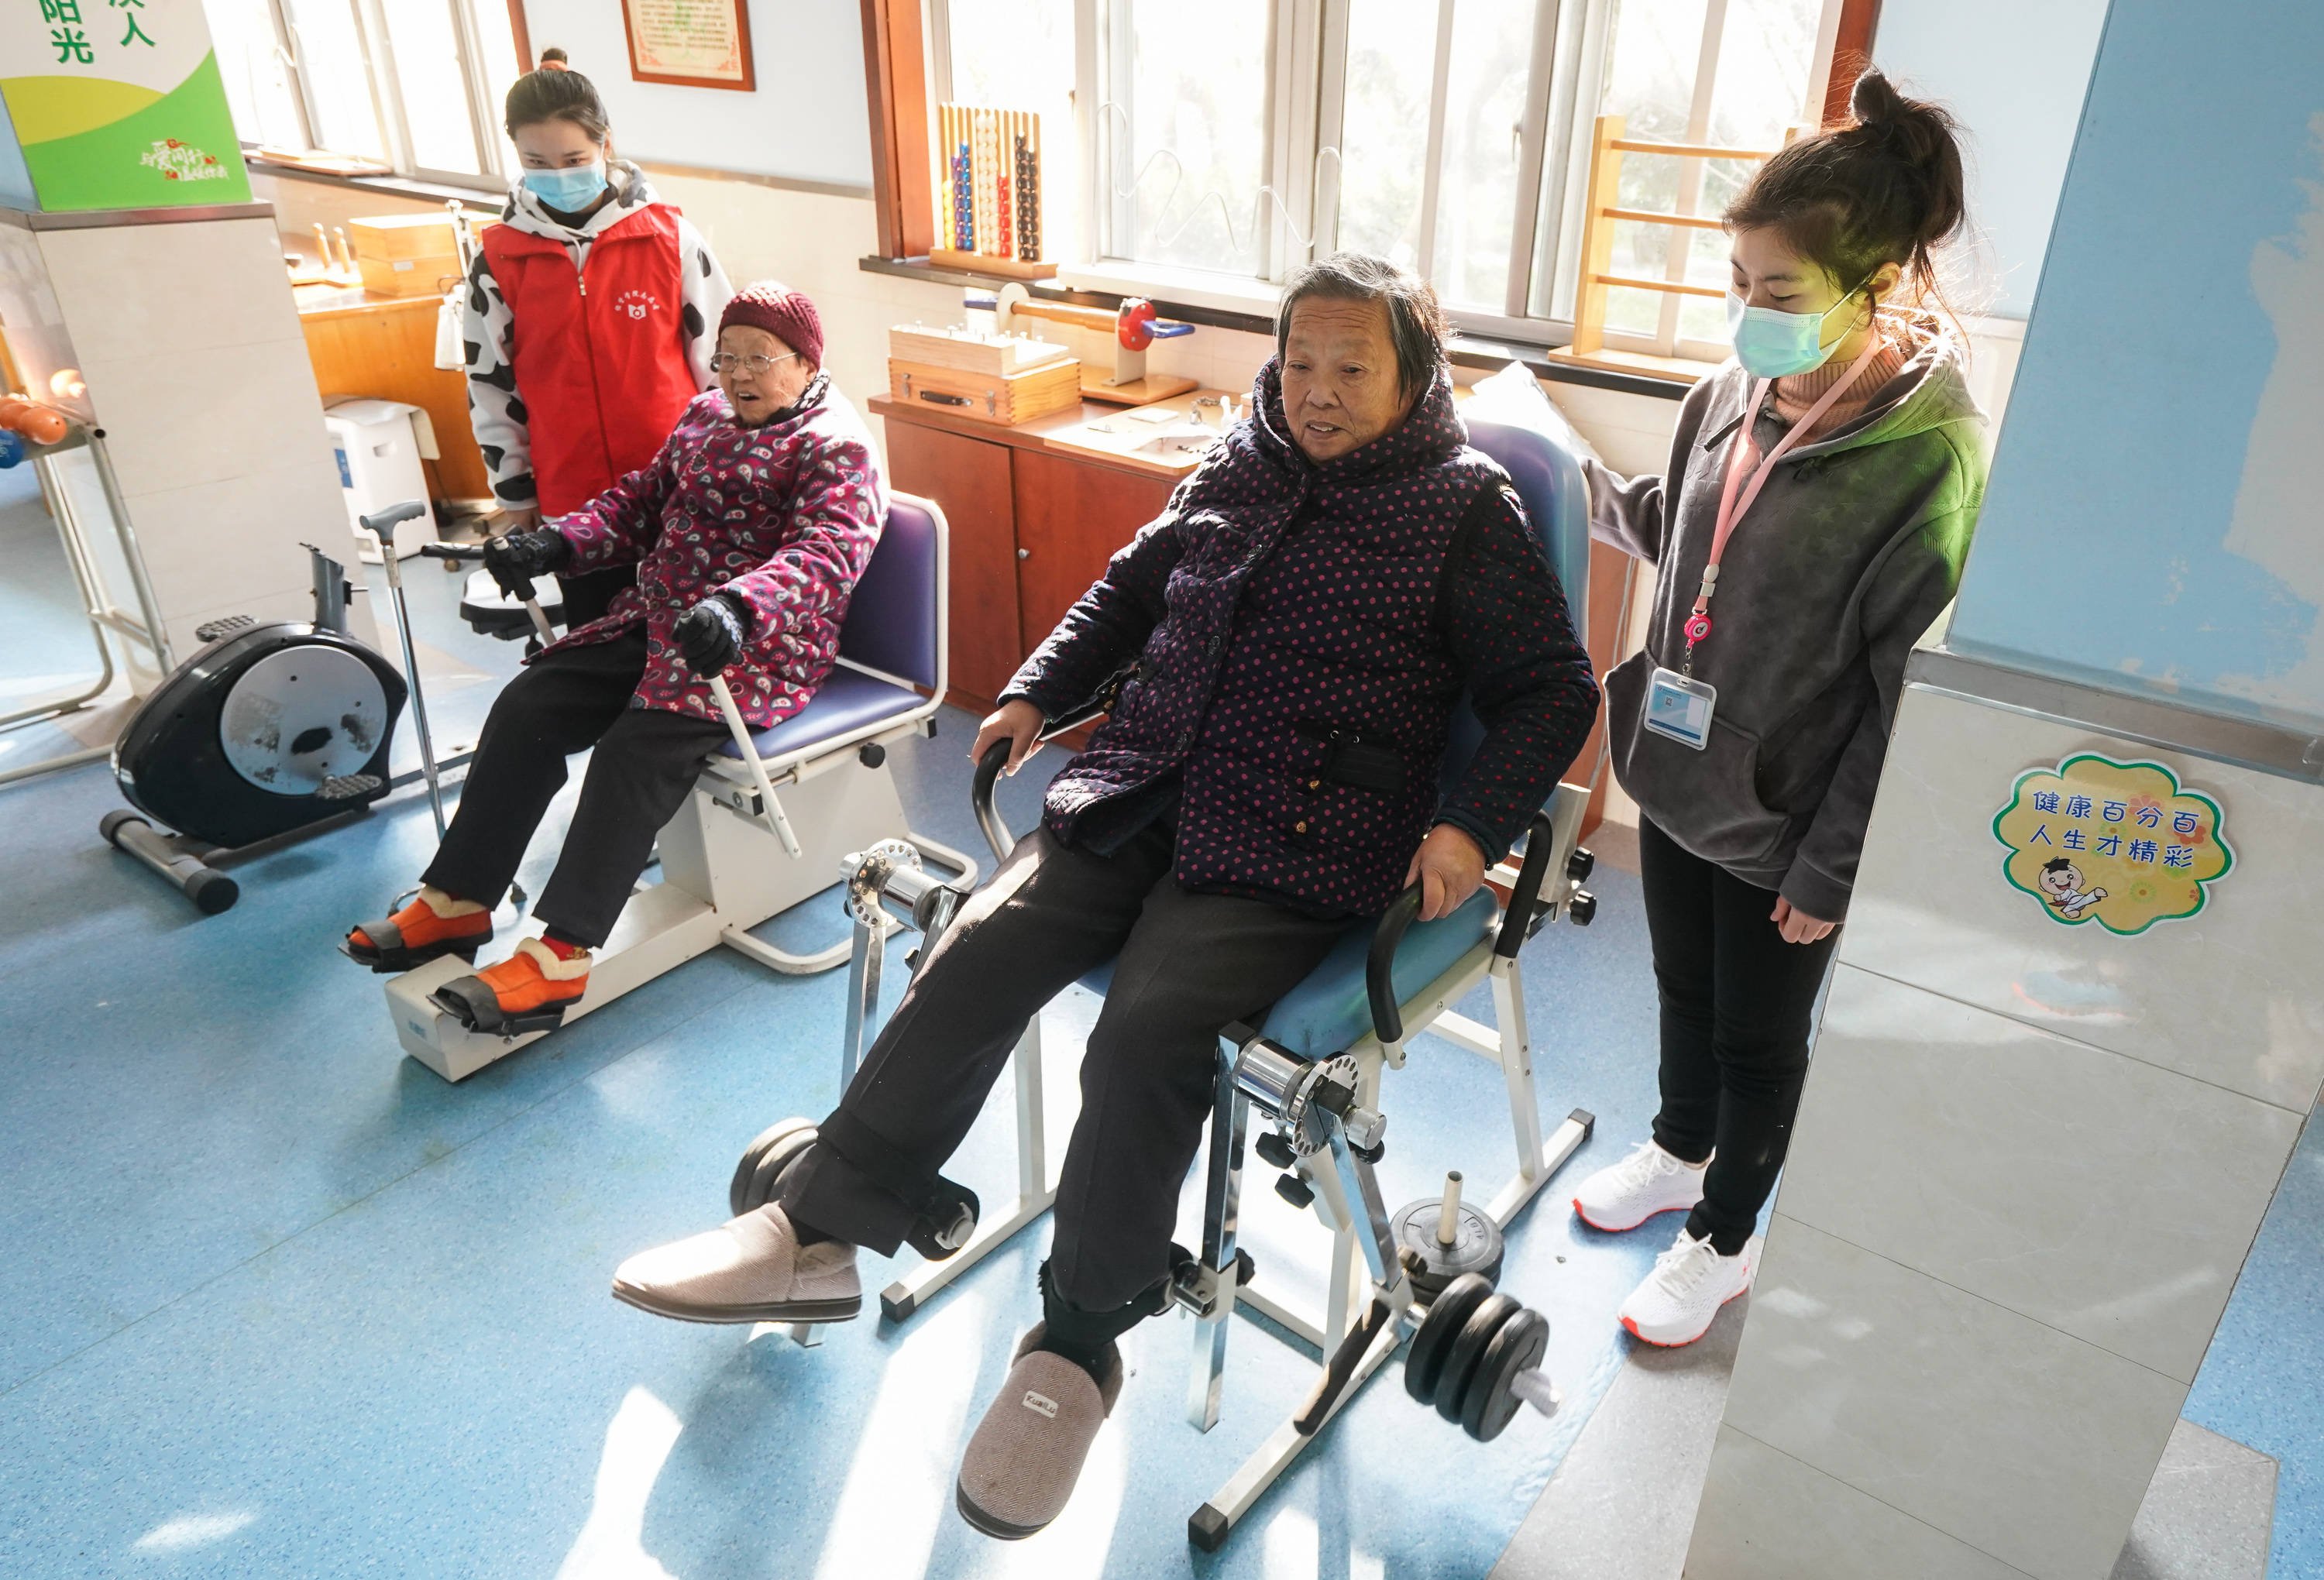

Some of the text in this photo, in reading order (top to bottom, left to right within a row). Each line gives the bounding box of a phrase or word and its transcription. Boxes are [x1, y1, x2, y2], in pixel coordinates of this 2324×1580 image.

[40, 0, 95, 64] 阳光
[2032, 790, 2199, 834] 健康百分百
[2029, 823, 2194, 868] 人生才精彩
